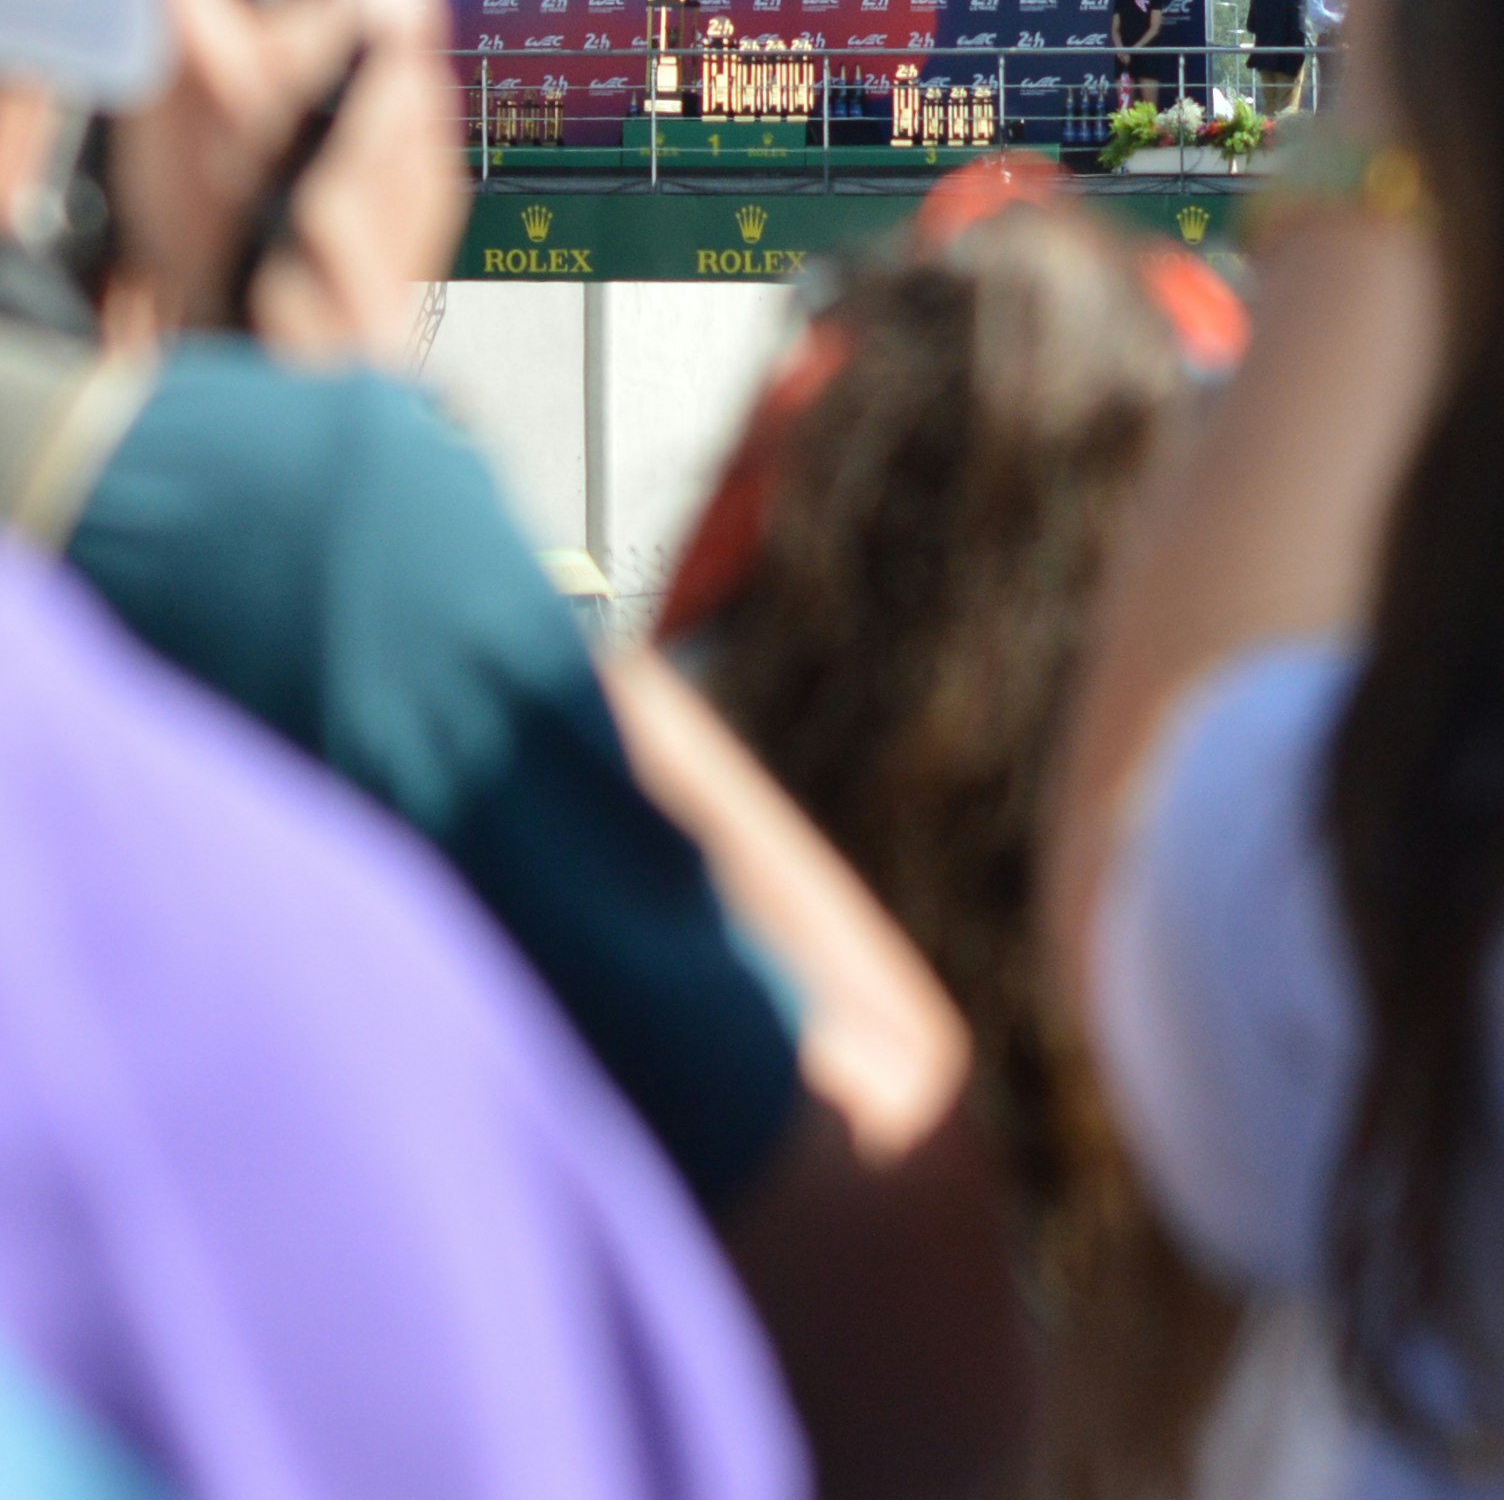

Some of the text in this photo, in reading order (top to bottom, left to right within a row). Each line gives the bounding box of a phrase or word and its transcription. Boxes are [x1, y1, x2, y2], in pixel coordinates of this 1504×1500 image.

[707, 133, 720, 157] 1
[483, 248, 593, 273] ROLEX
[696, 248, 808, 274] ROLEX
